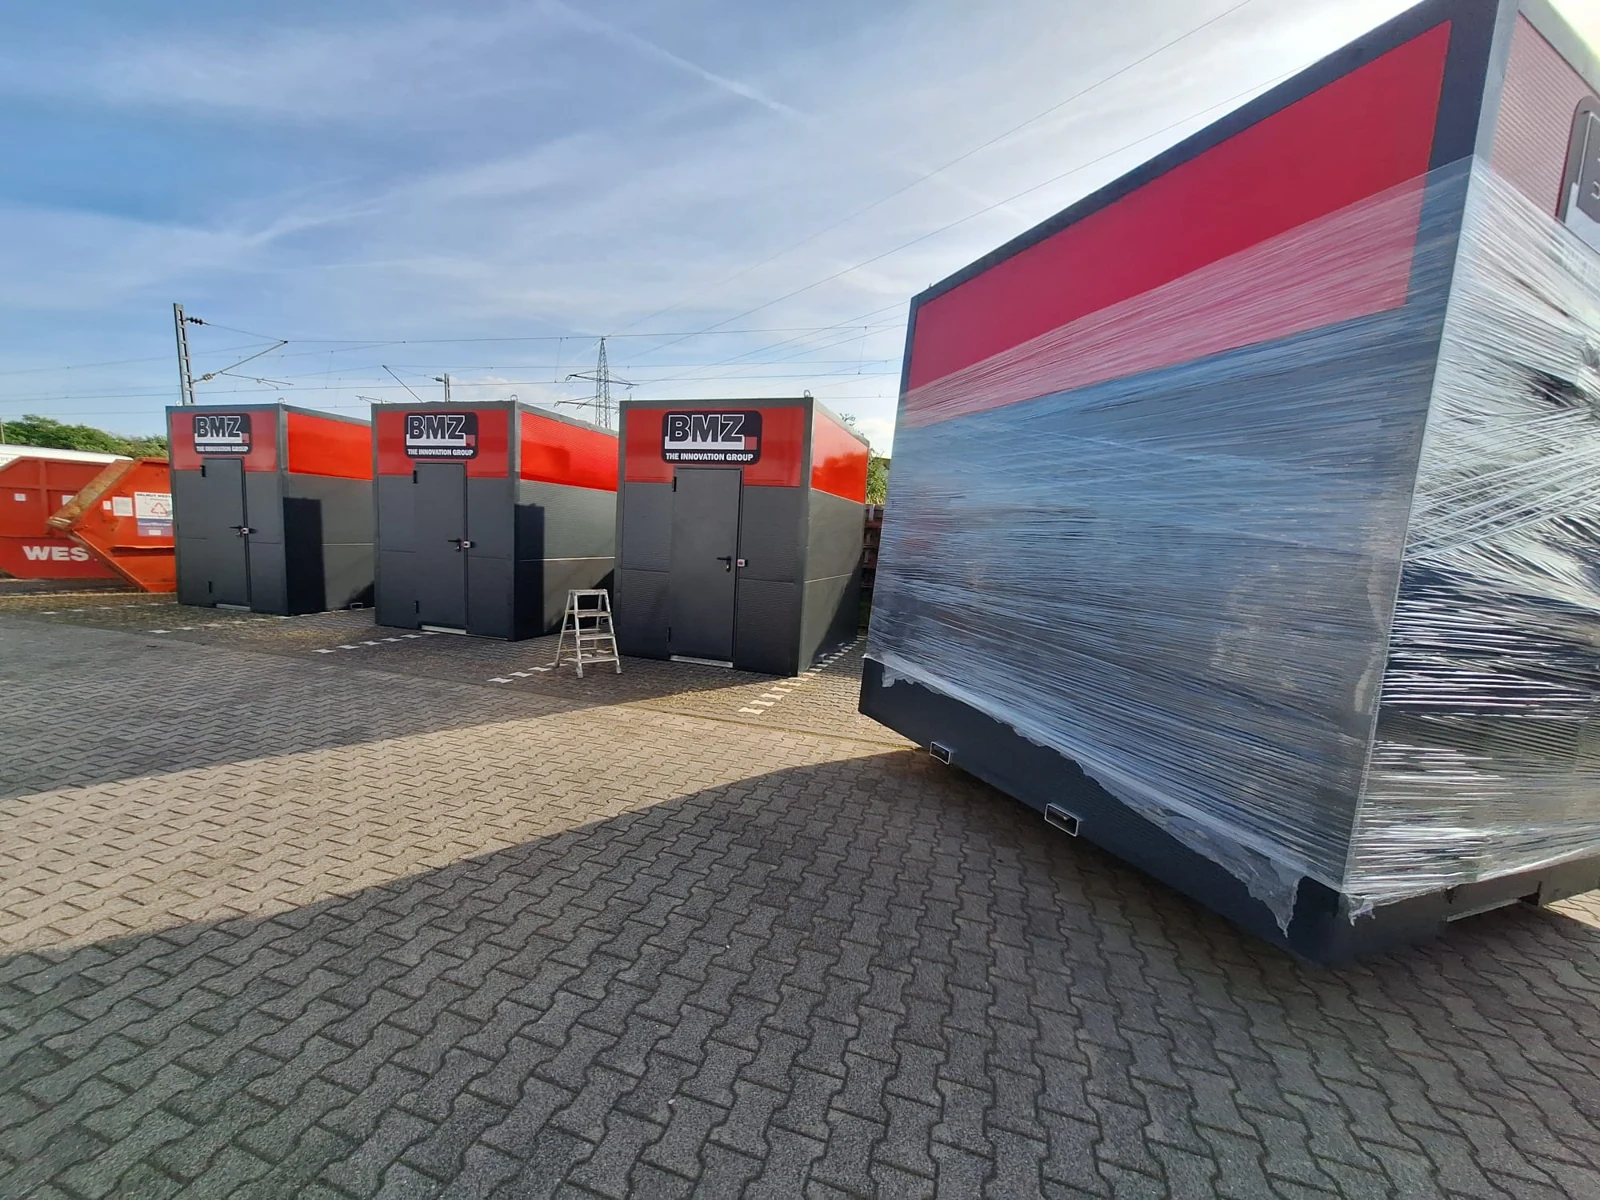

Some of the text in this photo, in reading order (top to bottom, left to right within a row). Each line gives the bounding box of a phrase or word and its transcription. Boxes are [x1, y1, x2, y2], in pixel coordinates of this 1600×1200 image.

[195, 415, 242, 438] BMZ
[407, 414, 466, 440] BMZ
[667, 413, 745, 443] BMZ
[418, 448, 452, 456] INNOVATION
[680, 453, 724, 461] INNOVATION
[726, 453, 754, 461] GROUP
[22, 545, 98, 562] WES
